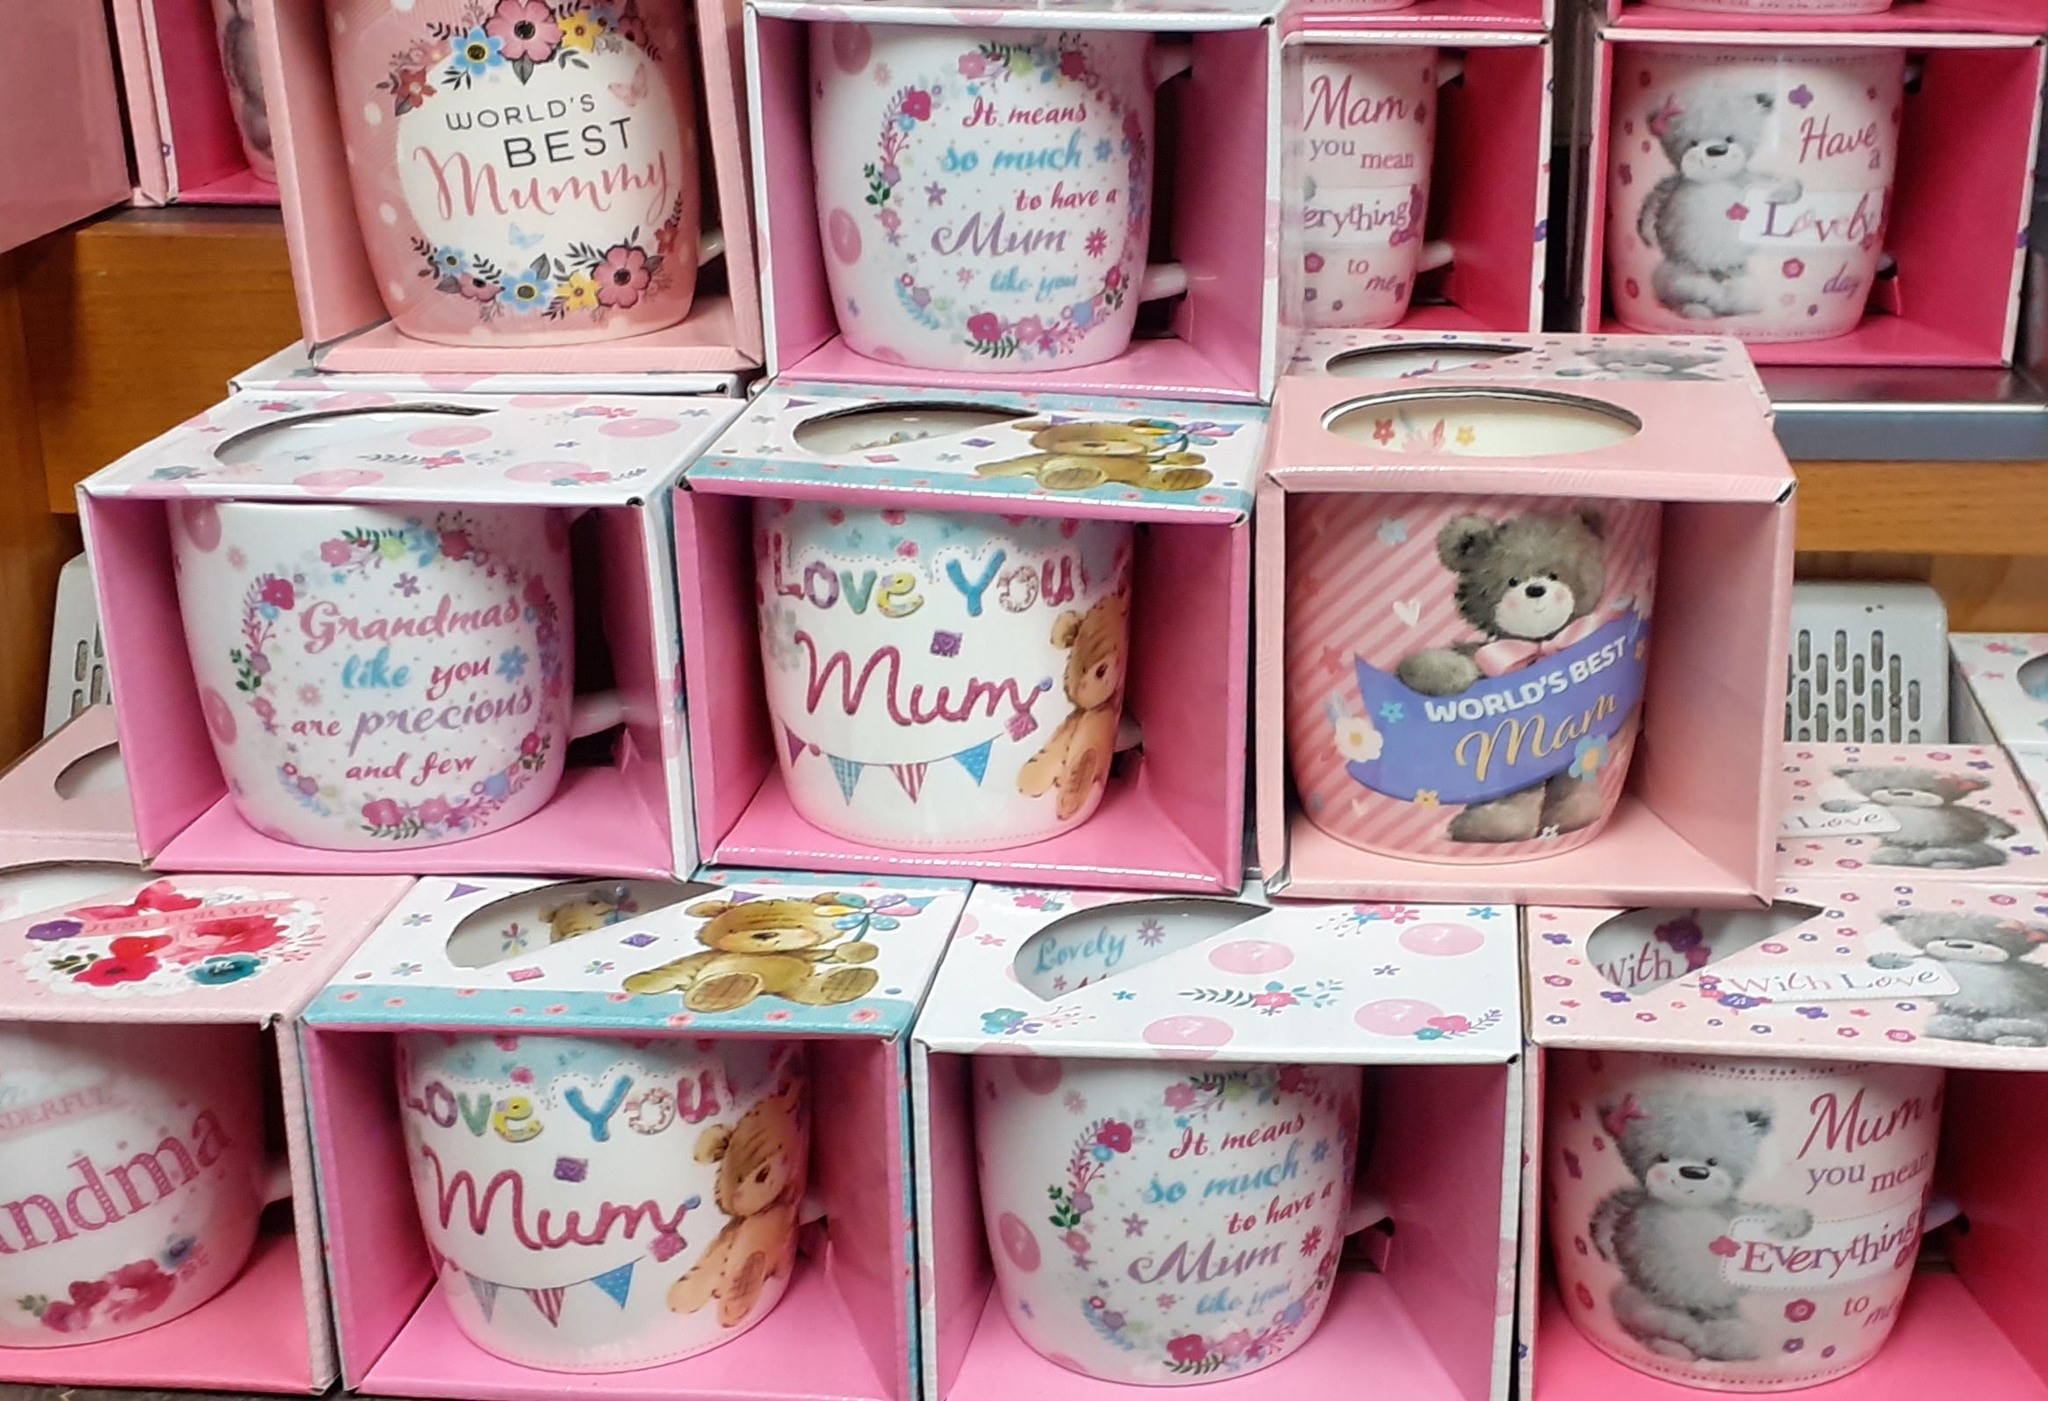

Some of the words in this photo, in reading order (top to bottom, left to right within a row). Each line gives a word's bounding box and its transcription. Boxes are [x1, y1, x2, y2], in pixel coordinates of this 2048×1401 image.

[445, 94, 595, 131] WORLD'S
[962, 96, 997, 127] It
[1008, 102, 1087, 125] means
[1303, 74, 1404, 131] Mam
[503, 117, 631, 168] BEST
[941, 146, 979, 172] so
[993, 127, 1082, 170] much
[1309, 138, 1355, 161] you
[1361, 152, 1414, 169] mean
[1799, 114, 1877, 164] Have
[1868, 151, 1880, 169] a
[413, 147, 667, 226] Mummy
[1016, 189, 1042, 211] to
[1051, 181, 1099, 209] have
[1106, 189, 1118, 204] a
[931, 211, 1067, 257] Mum
[1303, 200, 1409, 238] erything
[990, 265, 1028, 292] like
[1035, 274, 1078, 302] you
[1347, 259, 1369, 274] to
[300, 593, 520, 654] Grandmas
[342, 646, 410, 689] like
[426, 656, 491, 701] you
[794, 630, 1053, 727] Mum
[1424, 669, 1569, 723] WORLD'S
[1569, 635, 1626, 684] BEST
[291, 719, 342, 736] are
[349, 685, 533, 757] precious
[1455, 693, 1617, 782] Mam
[346, 752, 409, 779] and
[411, 752, 477, 787] few
[229, 903, 281, 915] YOU
[1034, 924, 1127, 975] Lovely
[1596, 941, 1675, 988] With
[1729, 971, 1832, 993] With
[1840, 970, 1940, 989] Love
[1169, 1126, 1208, 1159] It
[1220, 1113, 1305, 1150] means
[1797, 1088, 1922, 1160] Mum
[1143, 1179, 1187, 1203] so
[1203, 1139, 1299, 1198] much
[1806, 1163, 1866, 1195] you
[1870, 1152, 1929, 1194] mean
[422, 1145, 701, 1251] Mum
[1228, 1212, 1257, 1235] to
[1266, 1195, 1315, 1225] have
[1321, 1182, 1334, 1199] a
[1127, 1237, 1287, 1284] Mum
[1738, 1209, 1921, 1279] Everything
[1844, 1296, 1870, 1316] to
